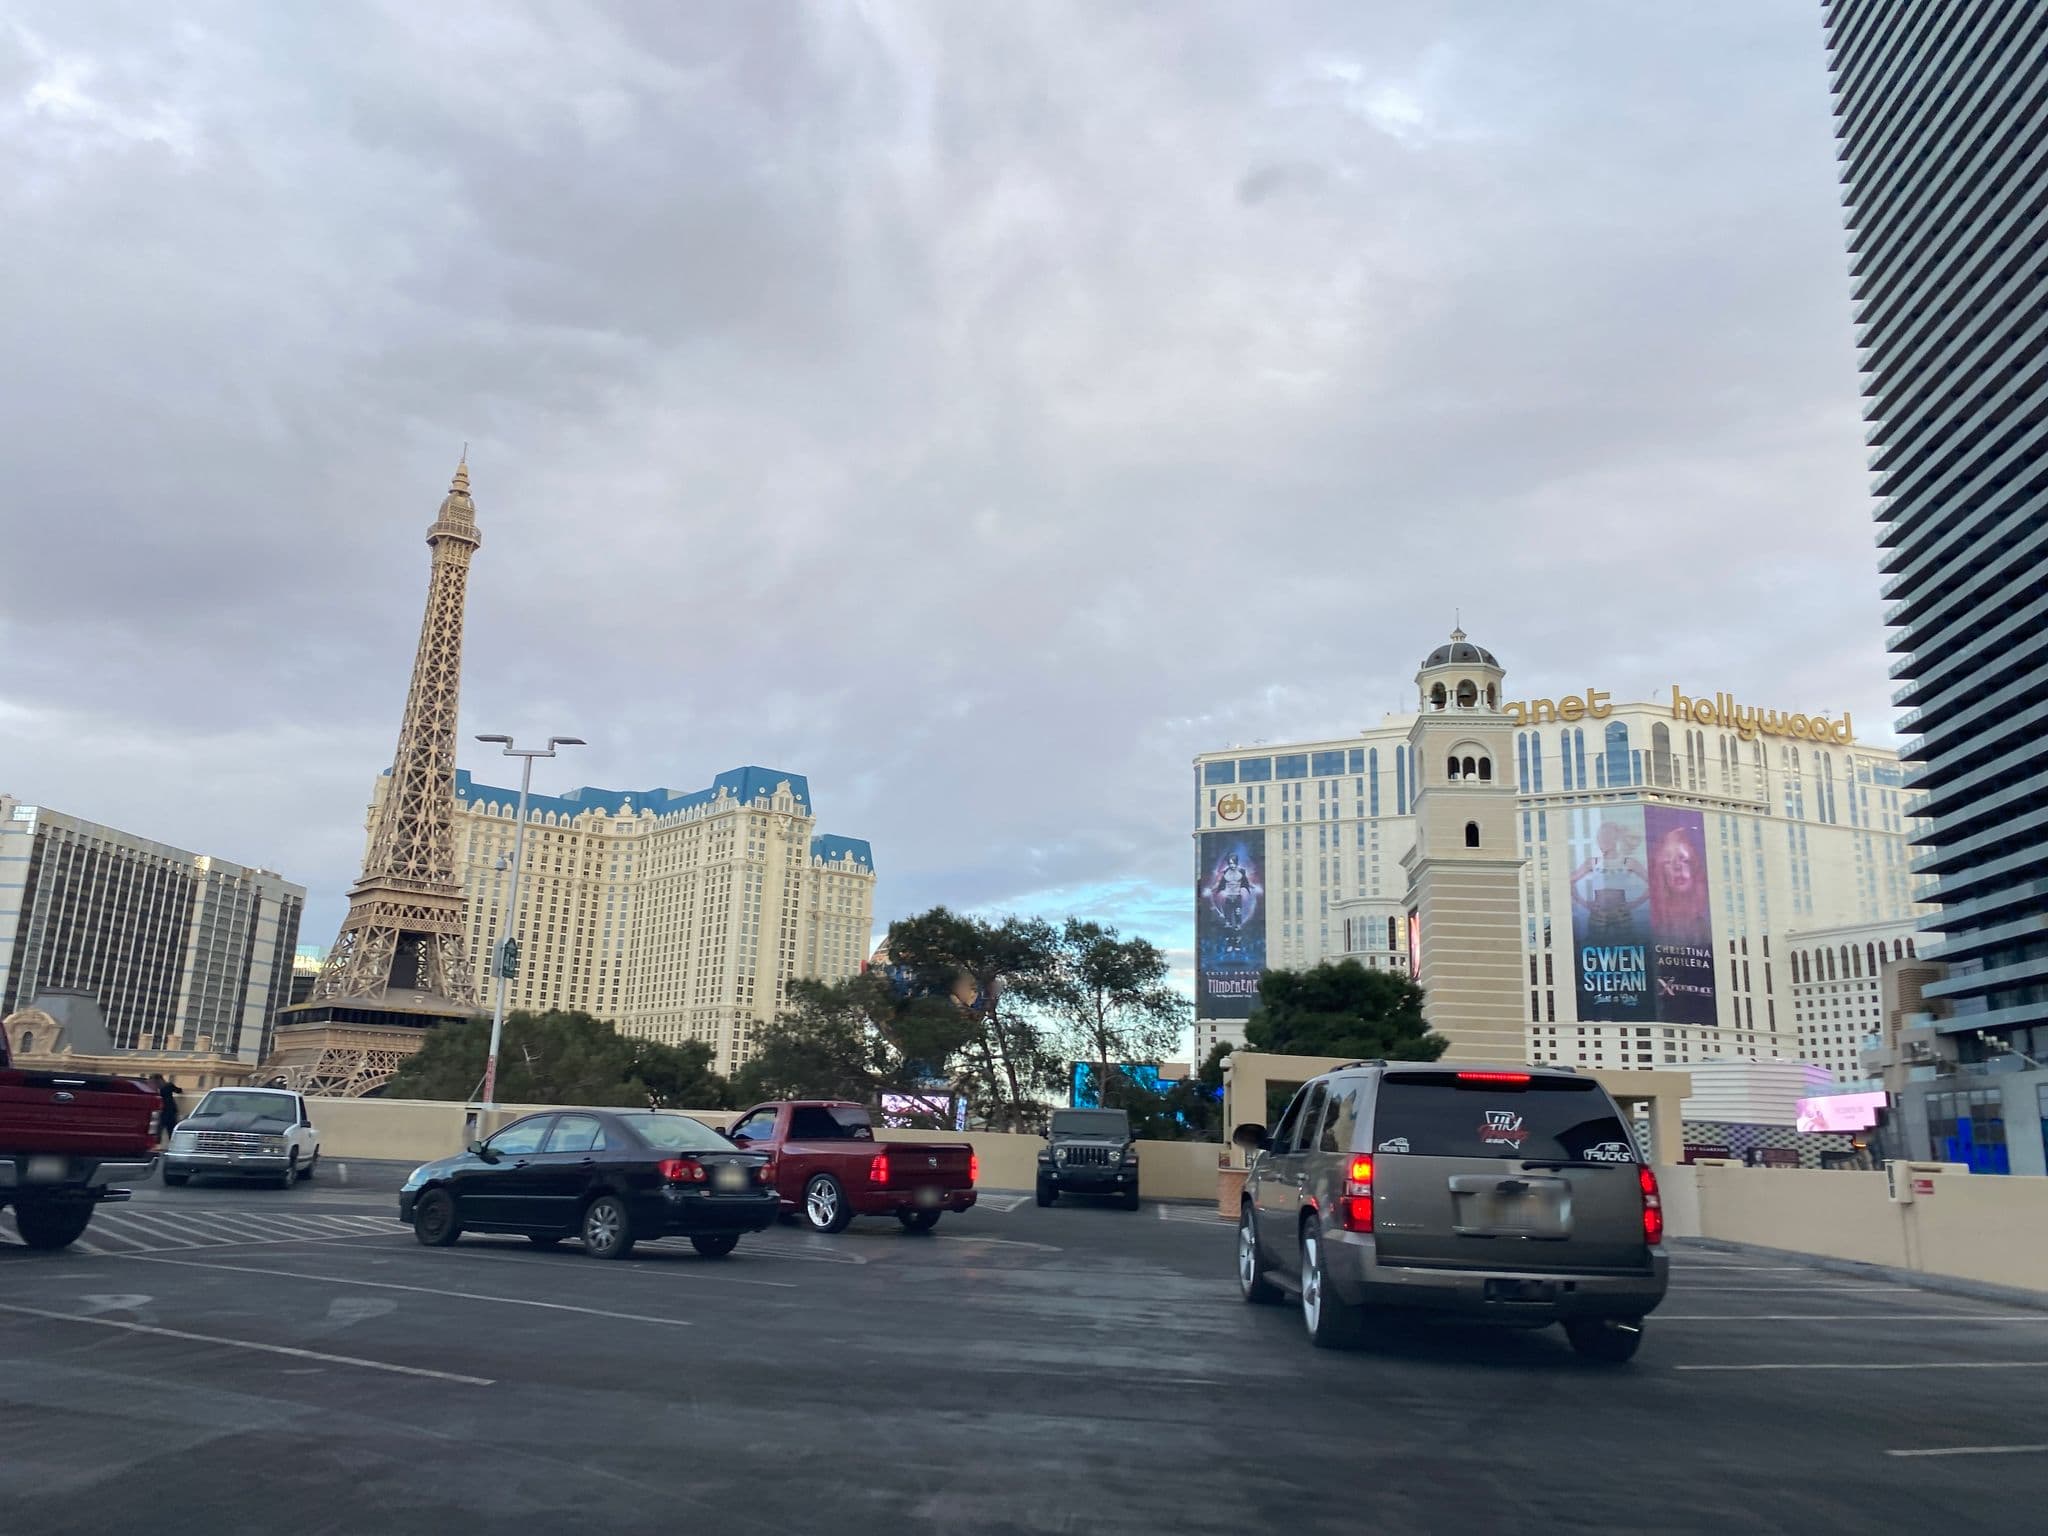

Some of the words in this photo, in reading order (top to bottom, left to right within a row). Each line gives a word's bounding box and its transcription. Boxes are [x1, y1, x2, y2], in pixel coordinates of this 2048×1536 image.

[1672, 684, 1853, 745] hollywood
[1582, 945, 1646, 972] GWEN
[1655, 944, 1711, 958] CHRISTINA
[1658, 956, 1710, 969] AGUILERA
[1583, 971, 1647, 992] STEFANI
[1587, 1151, 1632, 1162] TRUCKS
